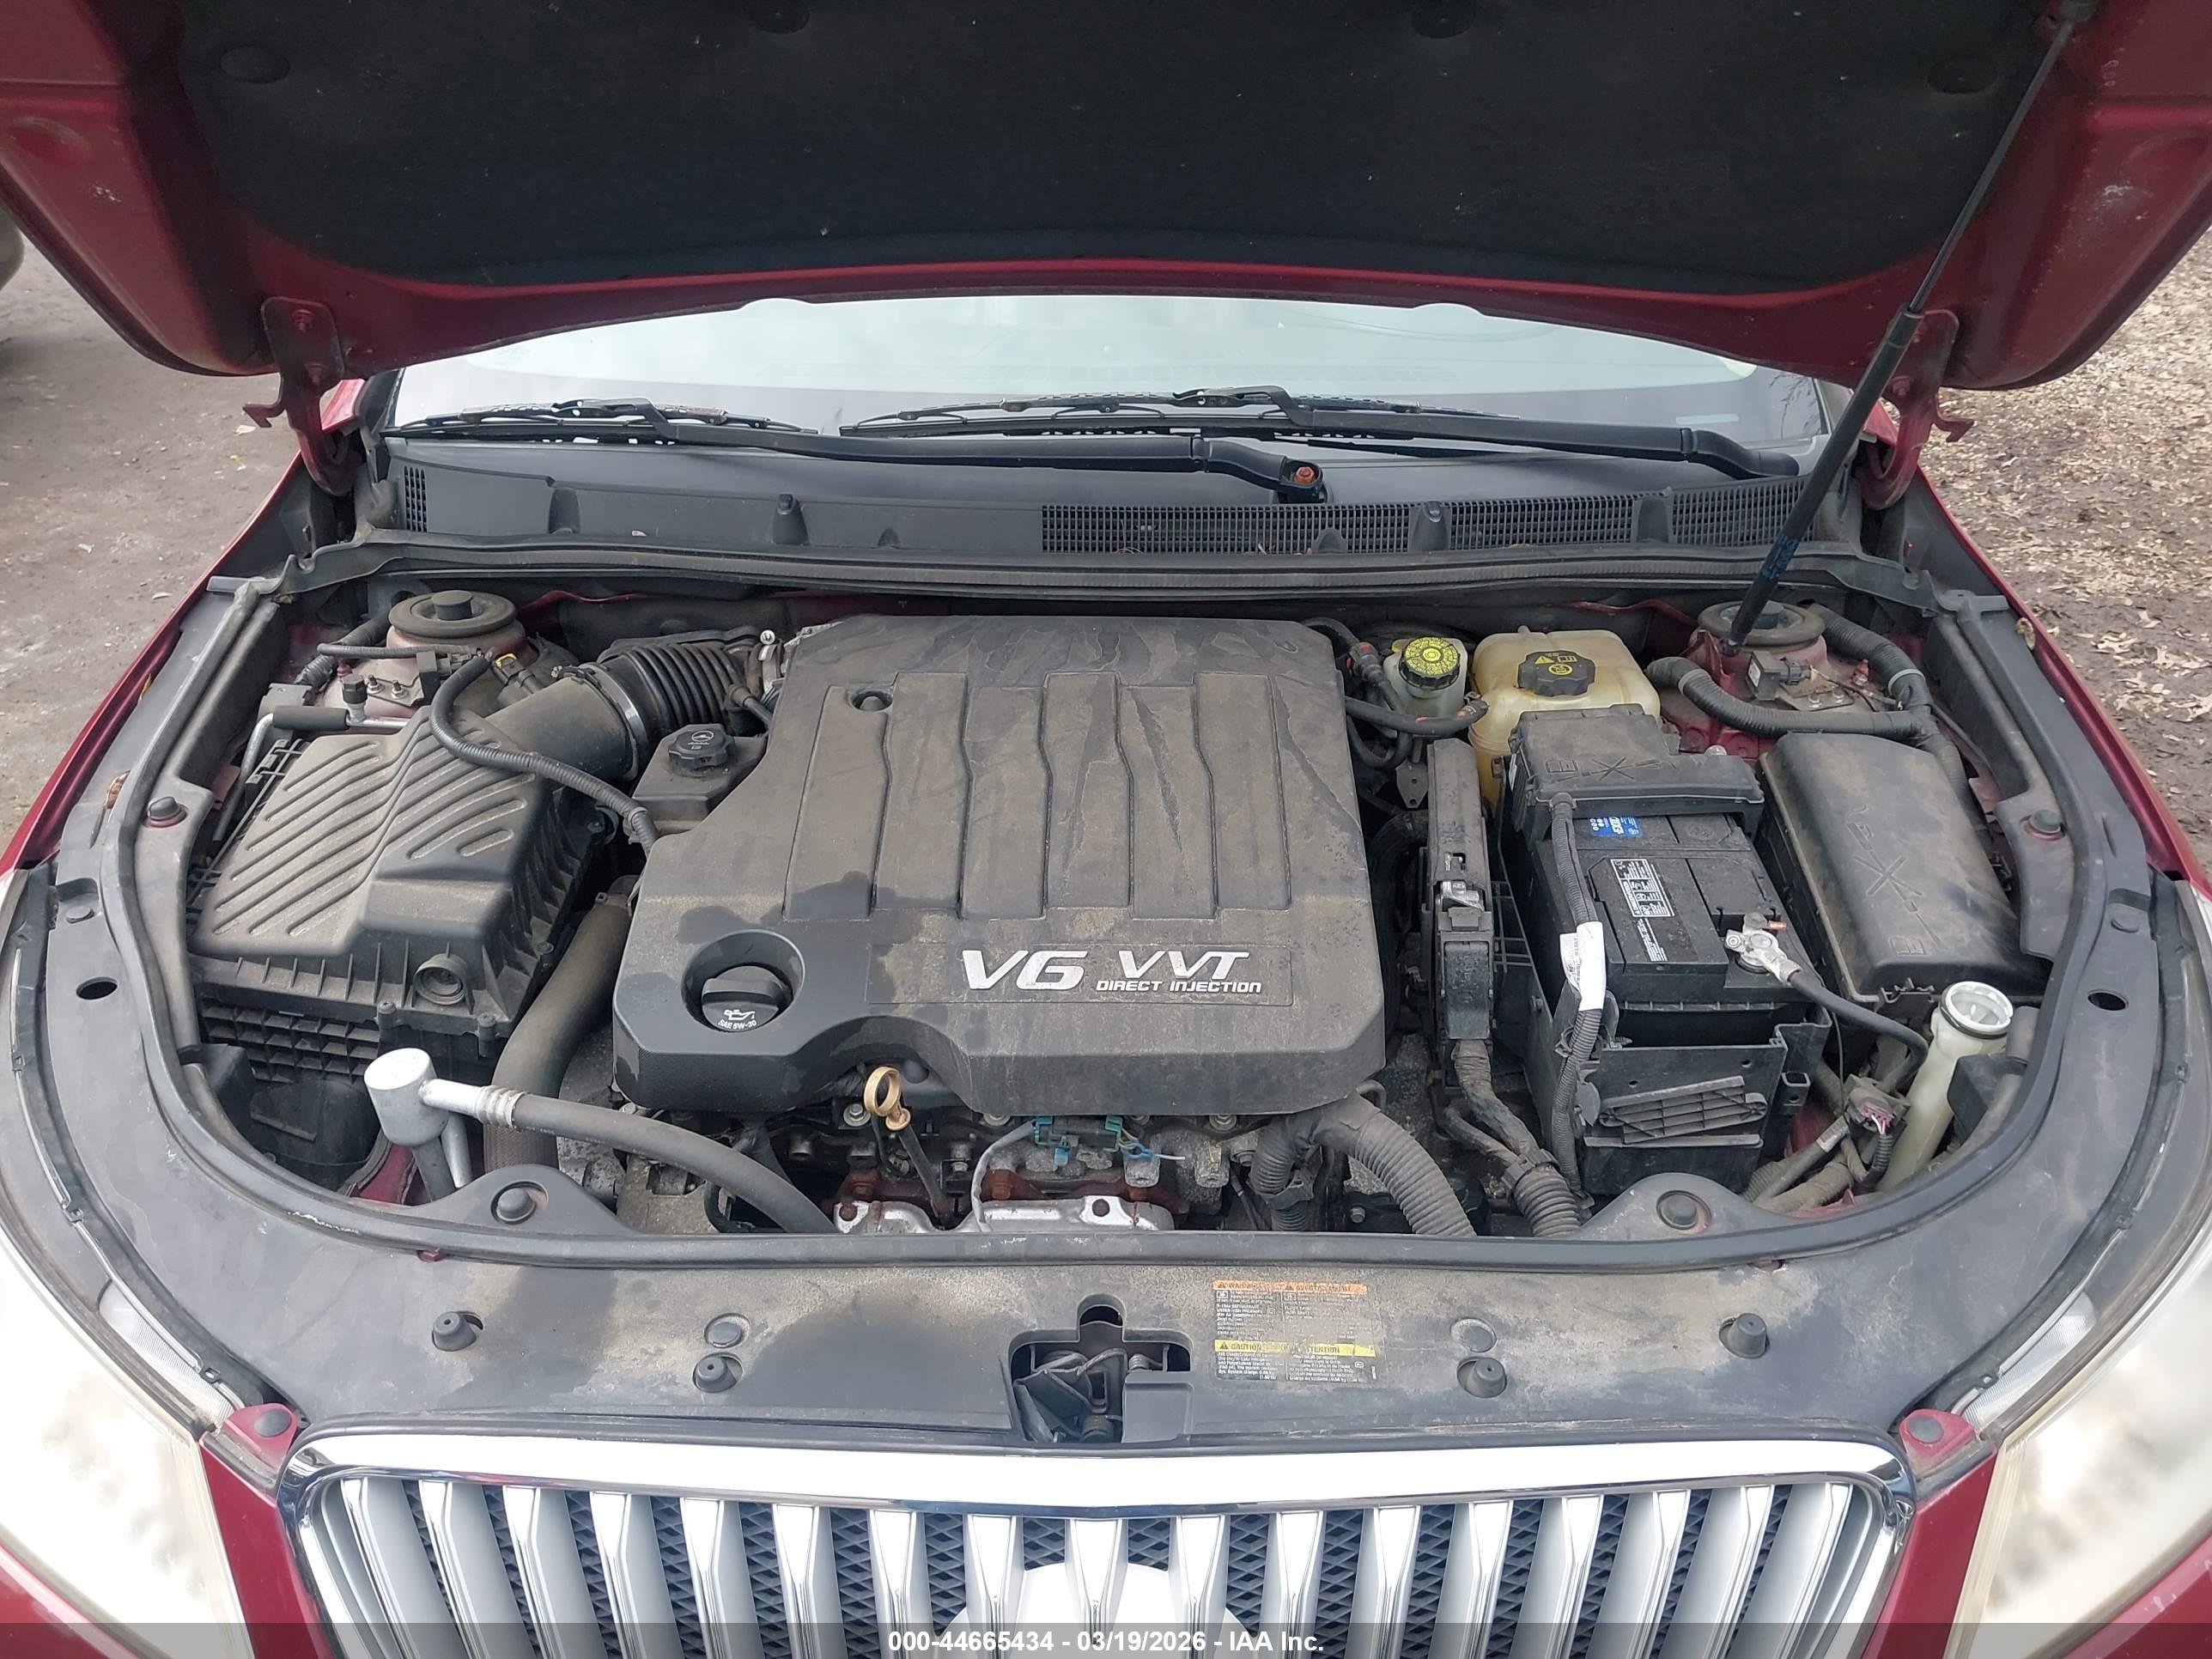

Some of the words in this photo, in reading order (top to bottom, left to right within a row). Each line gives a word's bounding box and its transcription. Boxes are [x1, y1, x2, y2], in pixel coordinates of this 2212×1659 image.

[962, 950, 1088, 990] V6
[1118, 951, 1249, 980] VVT
[1096, 981, 1163, 992] DIRECT
[1170, 981, 1261, 994] INJECTION
[718, 1019, 732, 1029] SAE
[732, 1020, 757, 1030] 5W-30
[1231, 1342, 1261, 1351] CAUTION
[1300, 1345, 1340, 1353] TENTION
